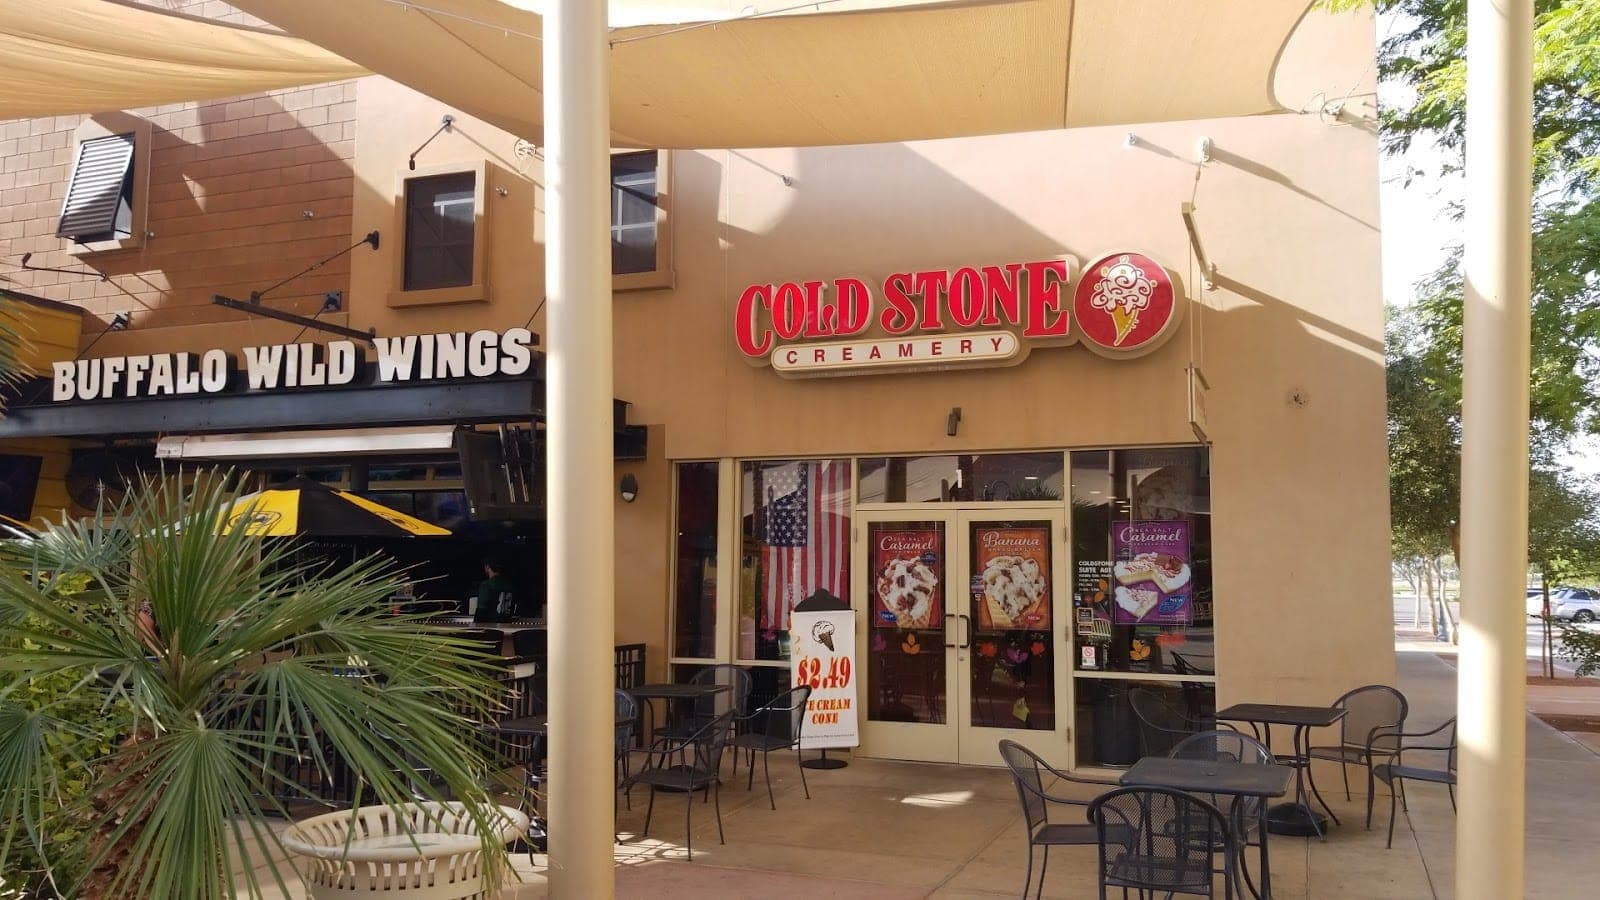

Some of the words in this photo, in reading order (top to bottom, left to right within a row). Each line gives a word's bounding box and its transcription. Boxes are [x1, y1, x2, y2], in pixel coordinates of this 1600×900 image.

[735, 277, 871, 358] COLD
[880, 259, 1071, 337] STONE
[786, 337, 1003, 365] CREAMERY
[52, 348, 228, 401] BUFFALO
[242, 339, 357, 389] WILD
[372, 327, 533, 382] WINGS
[880, 535, 934, 551] Caramel
[983, 531, 1041, 548] Banana
[1120, 526, 1182, 543] Caramel
[797, 655, 851, 689] $2.49
[816, 698, 851, 711] CREAM
[812, 712, 839, 725] CONE
